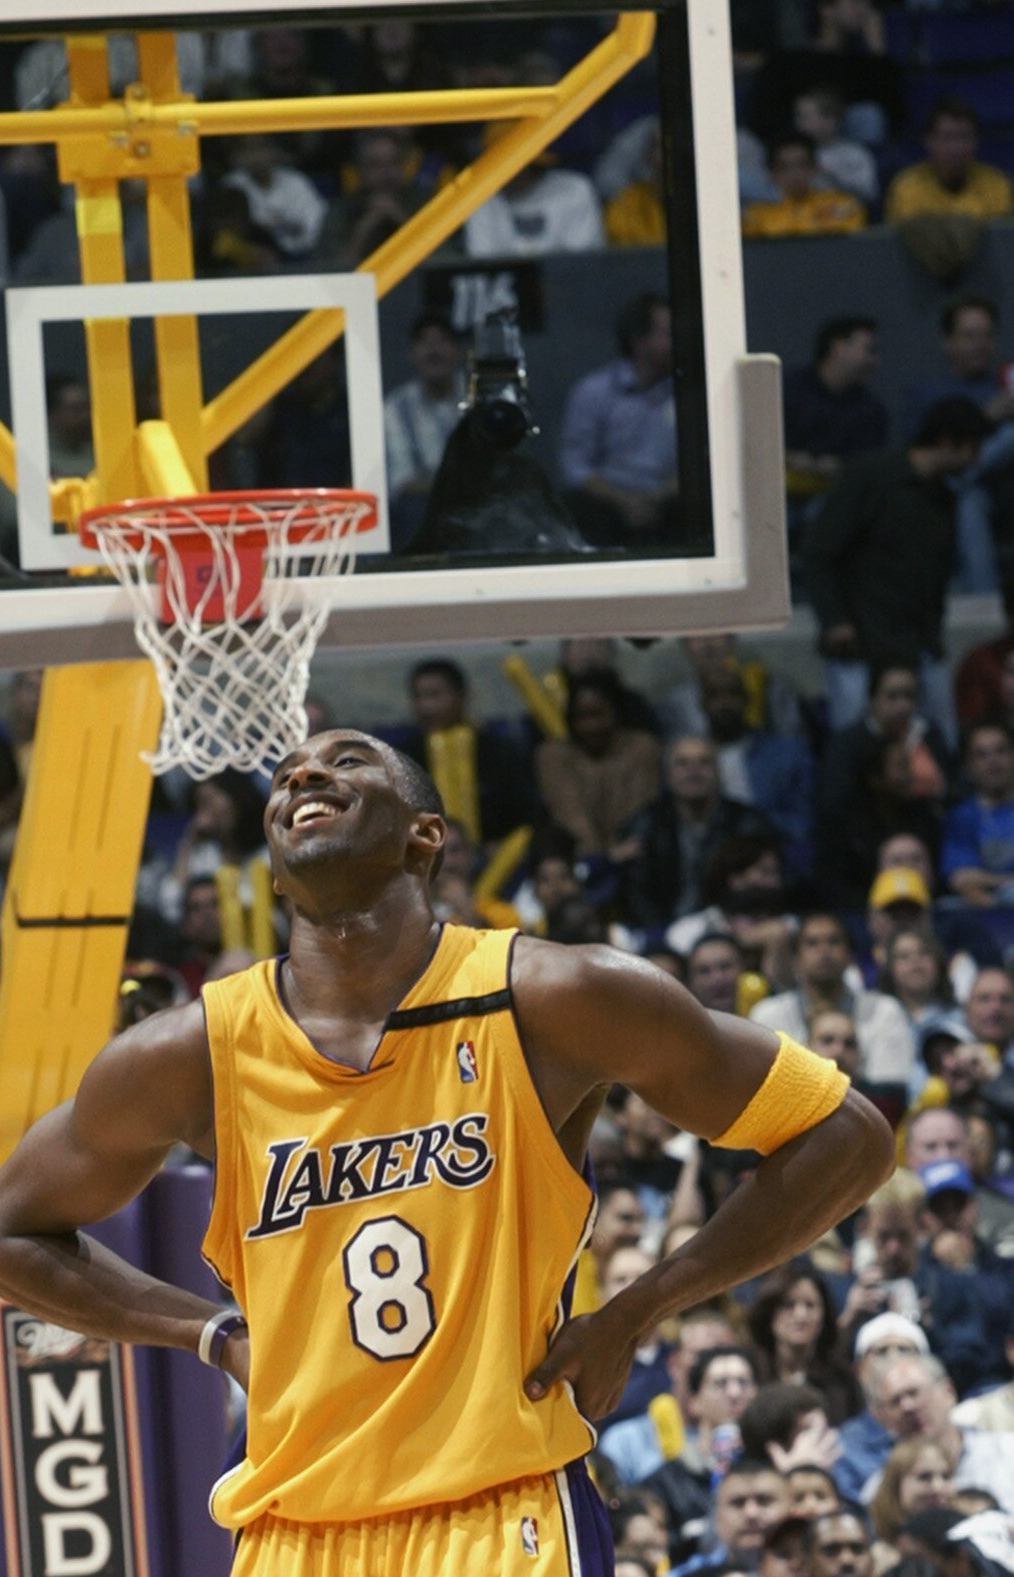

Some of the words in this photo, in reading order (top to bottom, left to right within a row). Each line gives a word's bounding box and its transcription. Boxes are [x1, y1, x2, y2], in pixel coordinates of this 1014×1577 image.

[244, 1112, 495, 1241] LAKERS
[342, 1215, 436, 1363] 8
[29, 1368, 112, 1577] MGD
